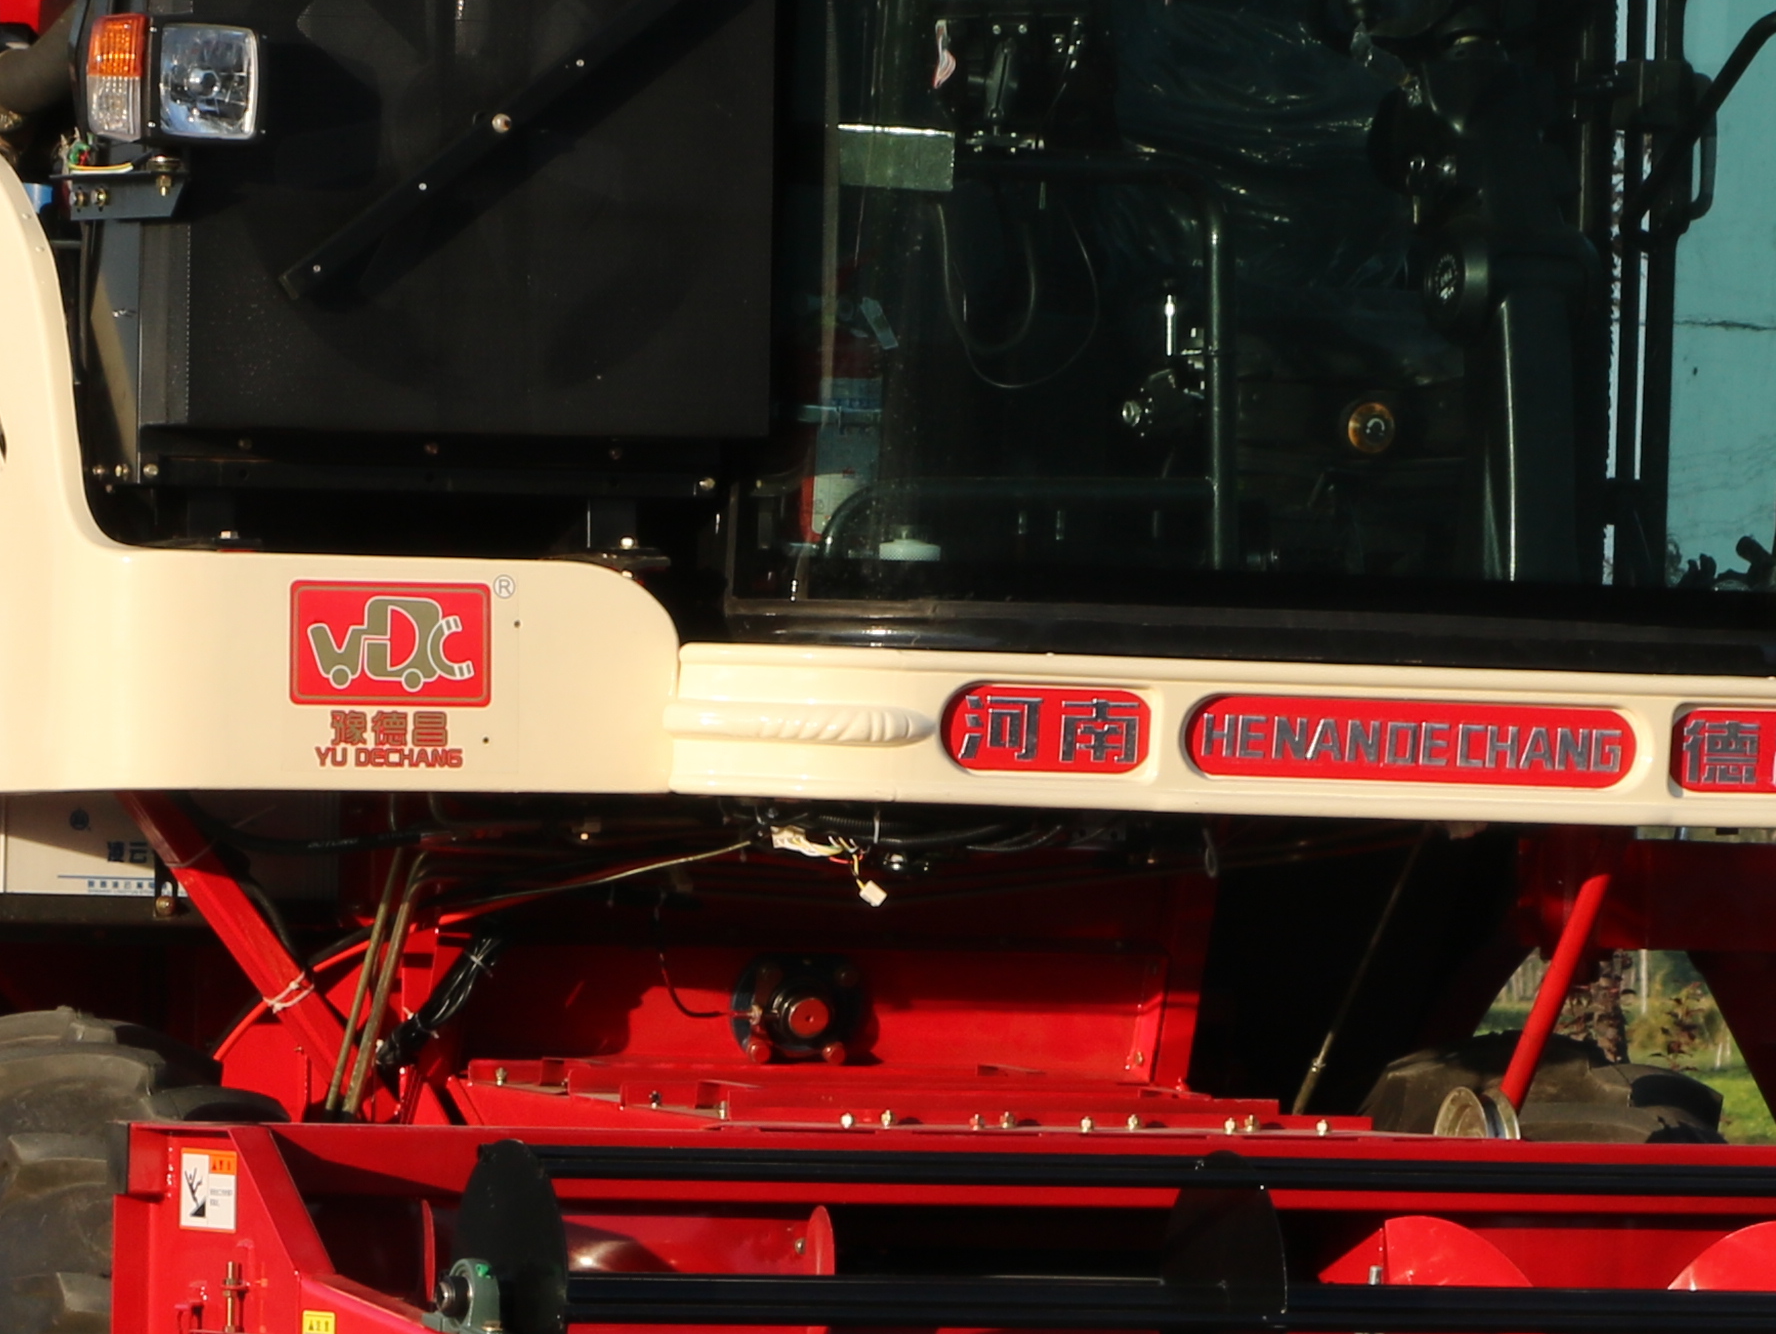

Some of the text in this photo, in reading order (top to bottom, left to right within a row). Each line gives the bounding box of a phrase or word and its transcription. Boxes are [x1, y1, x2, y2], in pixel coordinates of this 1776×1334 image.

[330, 709, 448, 747] 豫德昌
[958, 694, 1140, 764] 河南
[1201, 712, 1623, 773] HENANDECHANG
[315, 746, 464, 769] YU DECHANG
